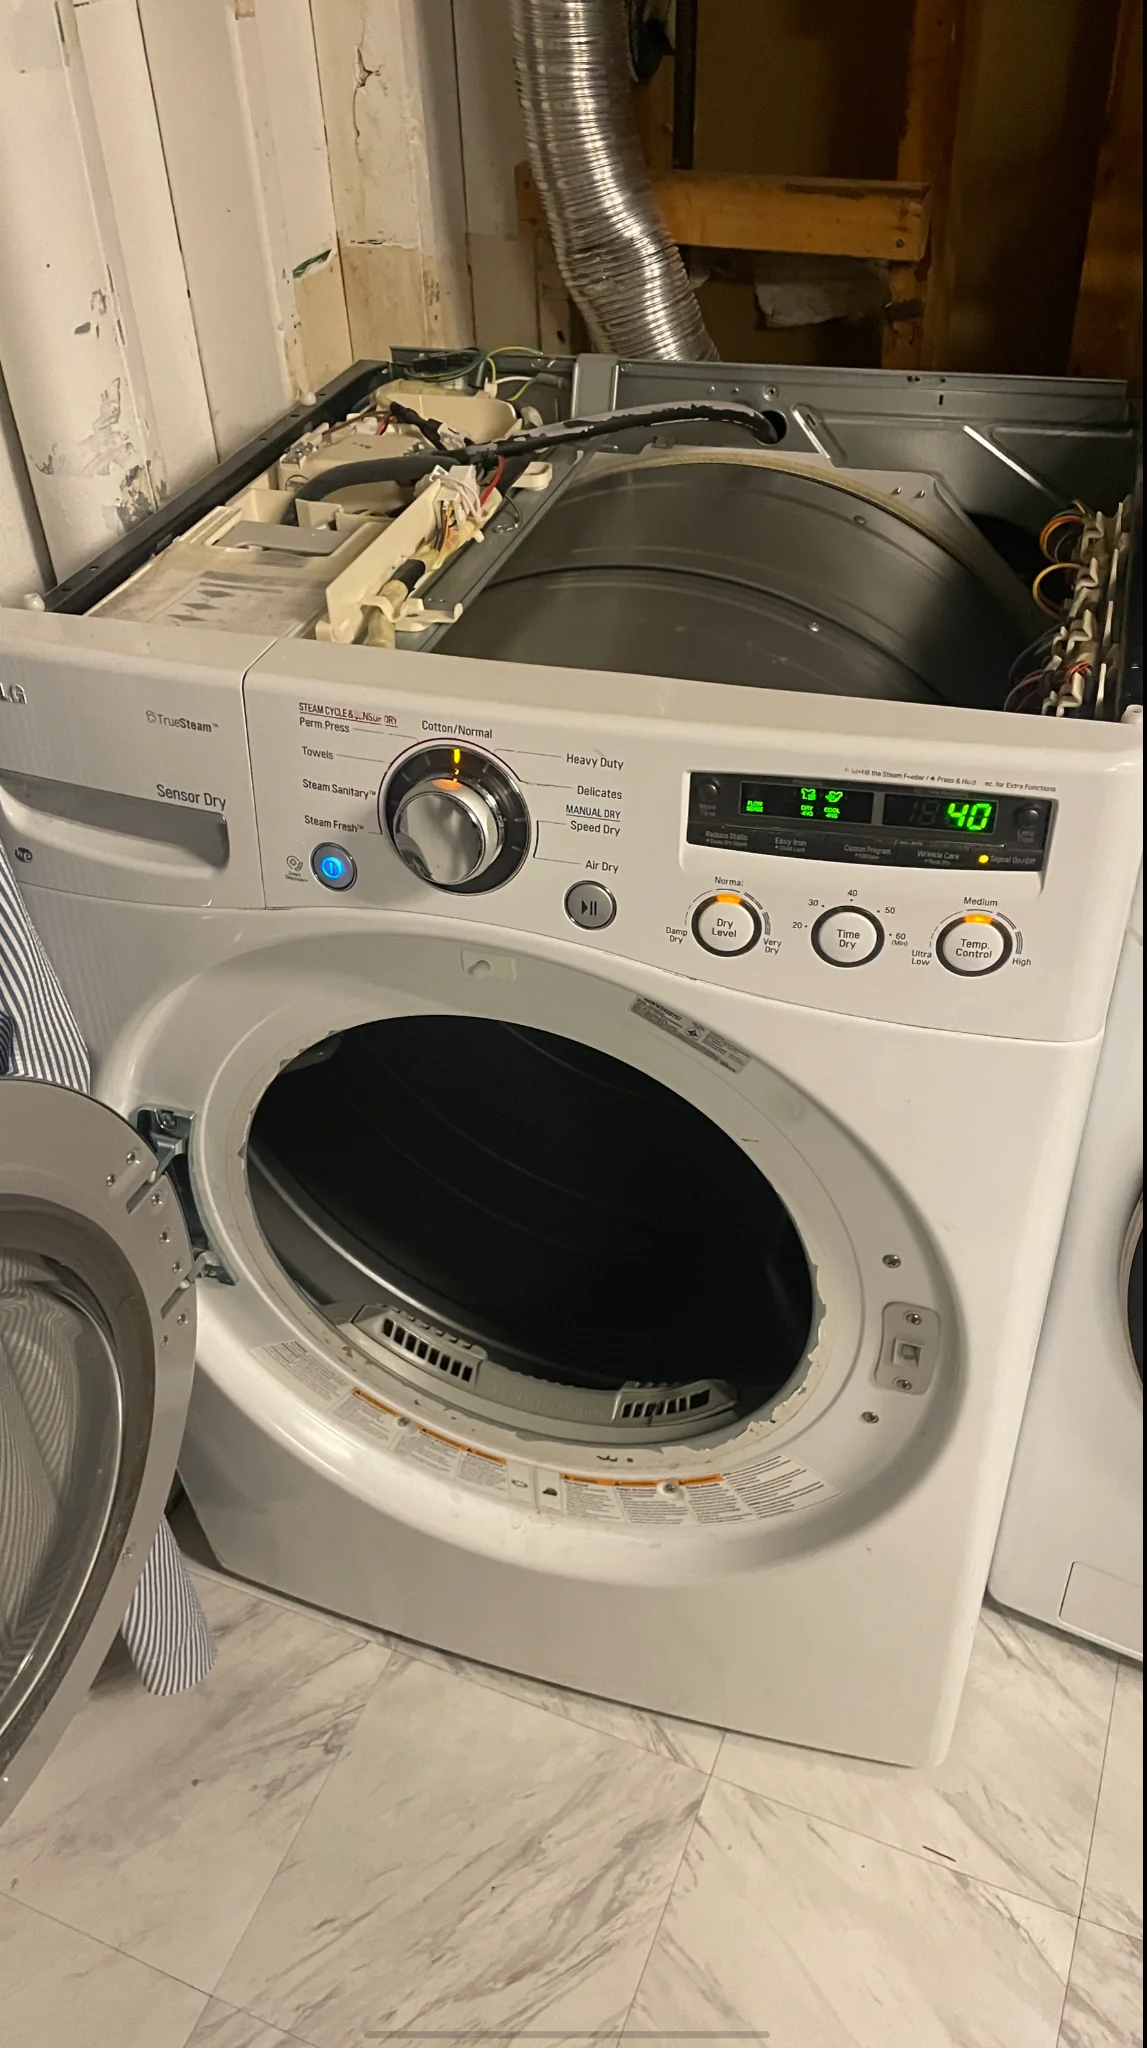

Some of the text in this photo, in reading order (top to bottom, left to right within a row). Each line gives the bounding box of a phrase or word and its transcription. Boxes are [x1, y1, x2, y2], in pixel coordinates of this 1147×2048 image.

[0, 682, 27, 704] LG
[299, 702, 324, 714] STEAM
[325, 706, 348, 718] CYCLE
[348, 709, 354, 719] &
[325, 720, 350, 733] Press
[421, 720, 493, 738] Cotton/Normal
[302, 746, 334, 760] Towels
[566, 753, 624, 771] Heavy Duty
[302, 778, 331, 792] Steam
[1024, 783, 1057, 792] Functions
[156, 784, 227, 811] Sensor Dry
[577, 785, 623, 800] Delicates
[566, 804, 621, 819] MANUAL DRY
[947, 802, 992, 831] 40
[304, 815, 331, 828] Steam
[570, 820, 621, 837] Speed Dry
[705, 830, 748, 841] Reduce Static
[775, 837, 806, 847] Easy Iron
[866, 846, 891, 855] Program
[917, 849, 960, 861] Wrinkle Care
[990, 855, 1012, 865] Signal
[585, 860, 619, 874] Air Dry
[847, 889, 858, 897] 40
[963, 896, 998, 907] Medium
[716, 918, 734, 929] Dry
[792, 921, 803, 929] 20
[665, 926, 688, 936] Damp
[711, 928, 737, 937] Level
[836, 929, 861, 939] Time
[669, 935, 683, 944] Dry
[763, 938, 782, 948] Very
[839, 939, 857, 950] Dry
[960, 938, 990, 950] Temp.
[765, 945, 779, 955] Dry
[911, 949, 932, 958] Ultra
[955, 948, 993, 959] Control
[911, 958, 930, 966] Low
[1012, 957, 1032, 967] High
